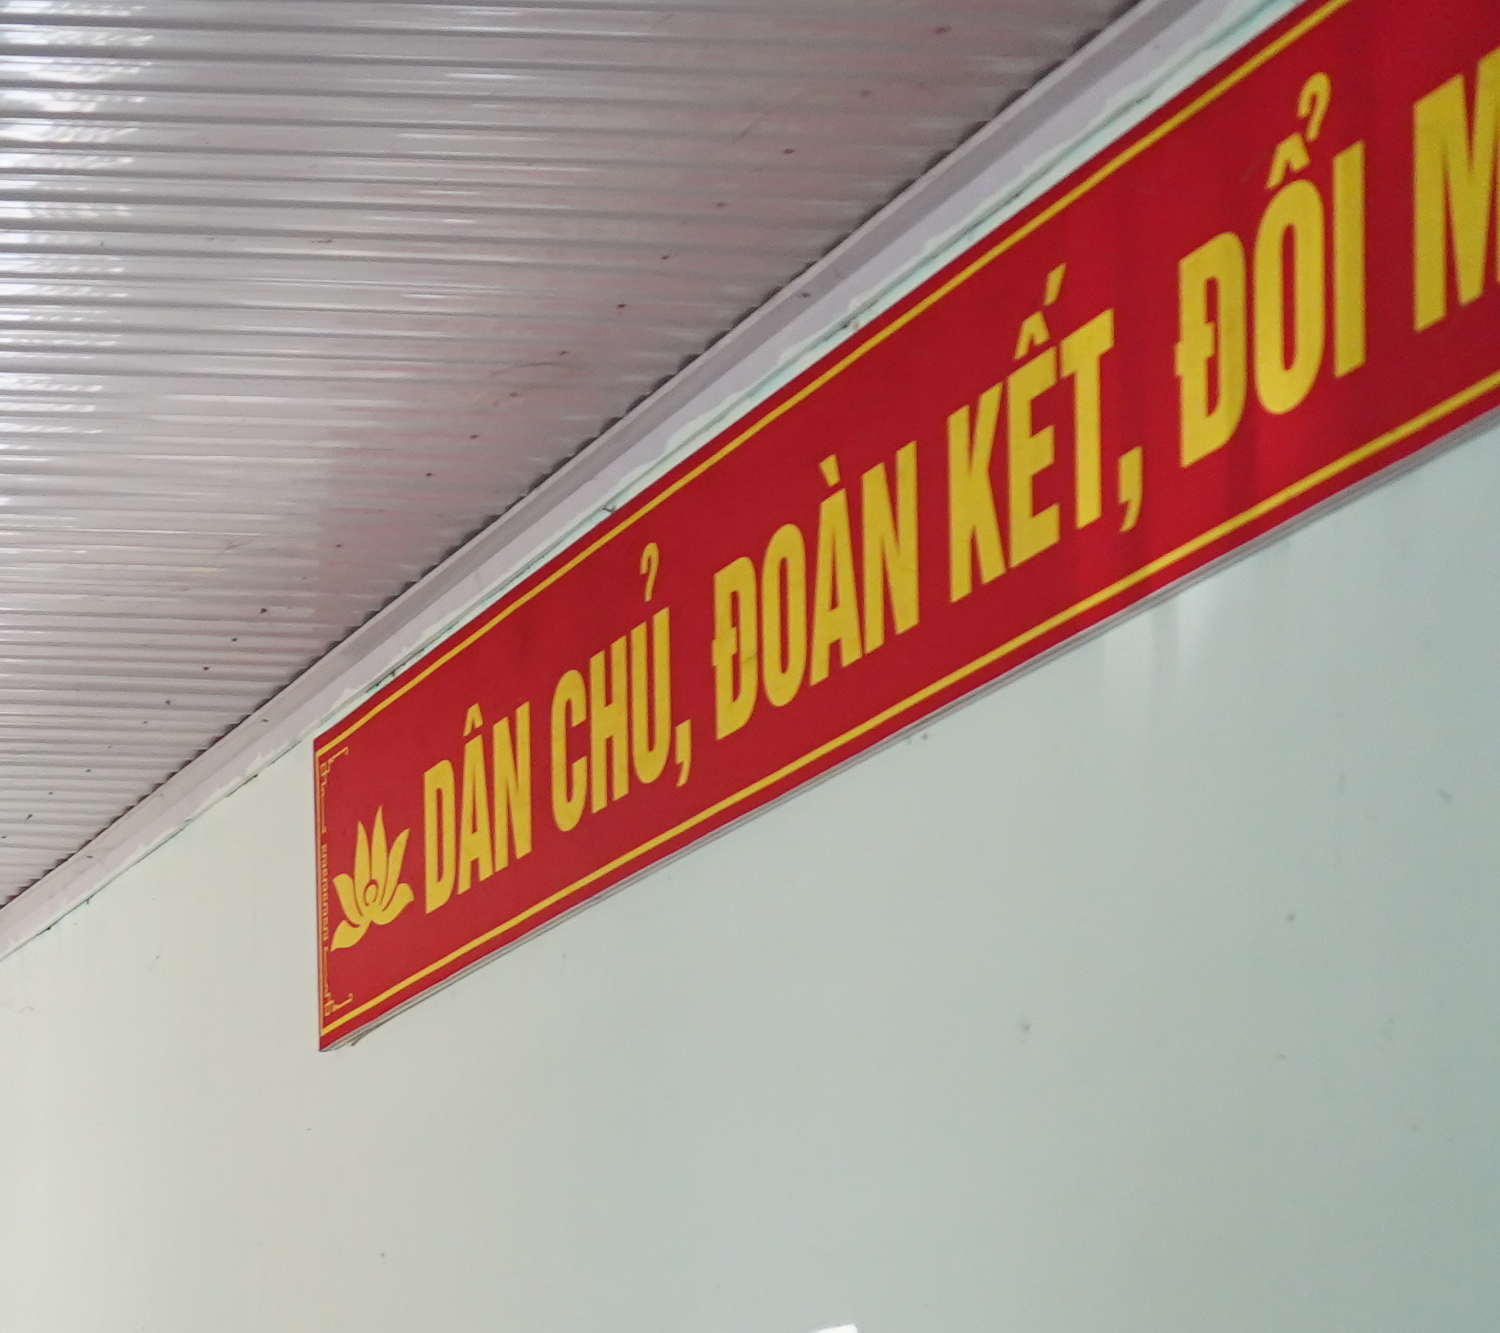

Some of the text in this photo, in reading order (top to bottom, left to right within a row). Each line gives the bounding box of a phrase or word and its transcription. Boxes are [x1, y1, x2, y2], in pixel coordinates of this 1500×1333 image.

[423, 701, 533, 915] DÂN
[550, 542, 692, 833] CHỦ,
[711, 440, 920, 740] ĐOÀN
[947, 264, 1143, 603] KẾT,
[1174, 72, 1366, 468] ĐỔI
